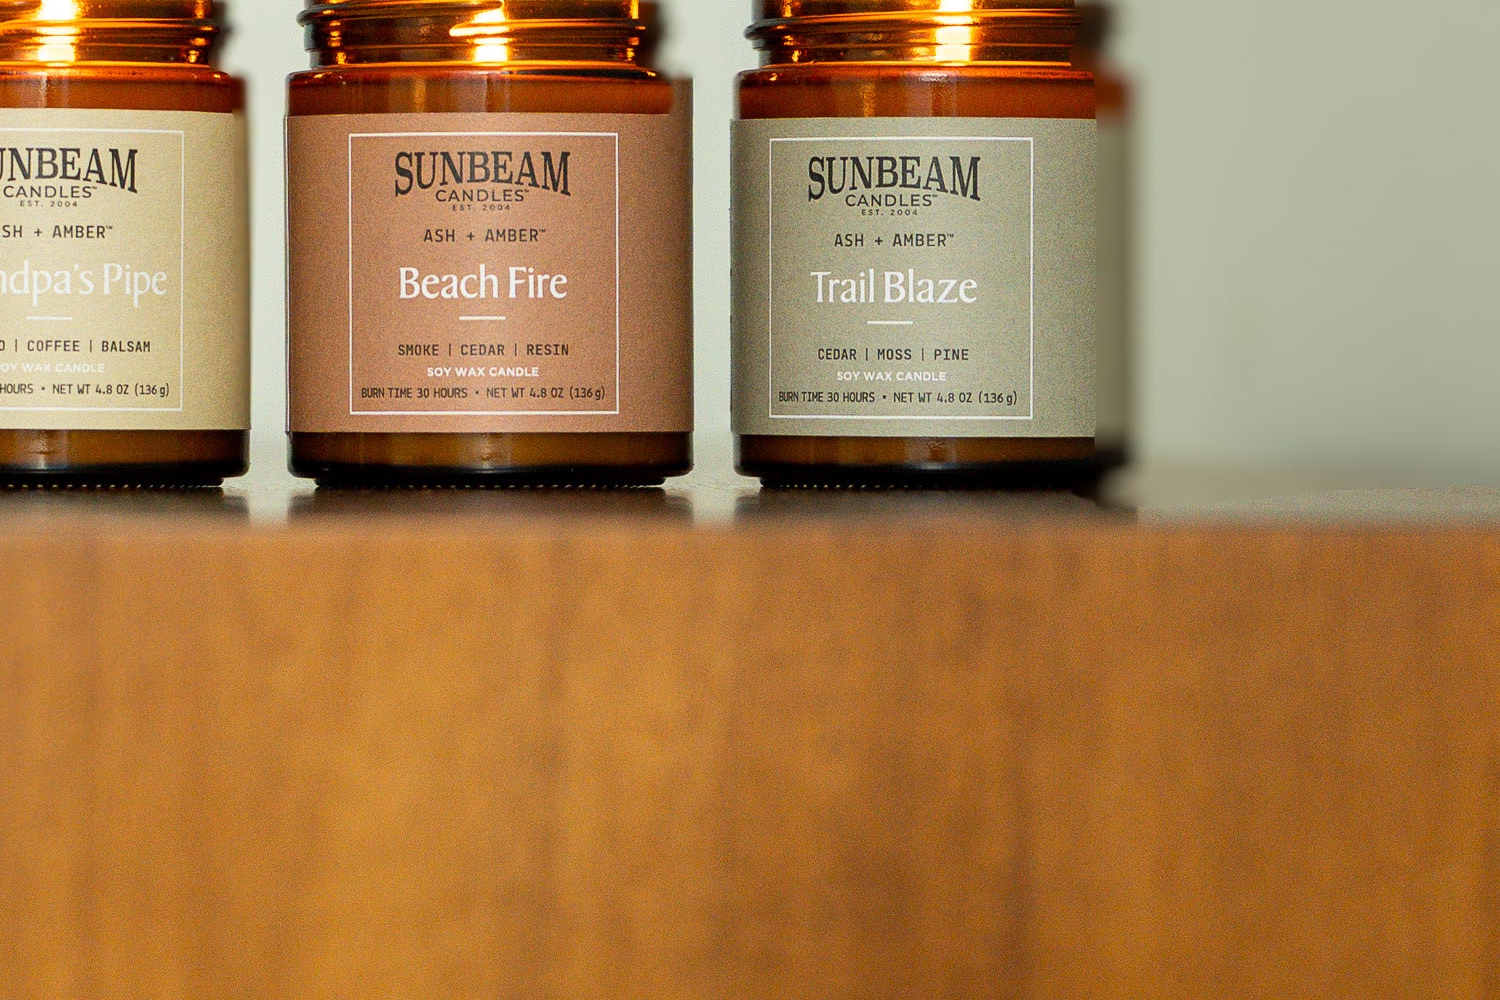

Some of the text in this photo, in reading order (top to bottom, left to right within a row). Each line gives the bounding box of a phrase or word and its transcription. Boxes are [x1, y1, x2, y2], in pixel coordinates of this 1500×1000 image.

[395, 151, 571, 197] SUNBEAM
[808, 156, 981, 202] SUNBEAM
[424, 229, 455, 242] ASH
[834, 234, 864, 246] ASH
[102, 262, 167, 308] Pipe
[400, 264, 568, 299] Beach Fire
[810, 268, 978, 303] Trail Blaze
[27, 340, 80, 352] COFFEE
[101, 341, 151, 352] BALSAM
[398, 344, 569, 356] SMOKE CEDAR RESIN
[818, 348, 969, 361] CEDAR MOSS PINE
[21, 363, 51, 372] WAX
[55, 363, 105, 373] CANDLE
[427, 367, 539, 377] SOY WAX CANDLE
[836, 372, 946, 381] SOY WAX CANDLE
[0, 384, 33, 394] HOURS
[52, 384, 73, 394] NET
[77, 384, 91, 394] WT
[95, 384, 112, 395] 4.8
[116, 384, 129, 395] OZ
[361, 388, 384, 398] BURN
[388, 388, 412, 398] TIME
[417, 388, 430, 398] 30
[434, 388, 468, 398] HOURS
[486, 388, 507, 398] NET
[511, 388, 525, 398] WT
[529, 388, 547, 398] 4.8
[550, 388, 564, 398] OZ
[778, 392, 798, 402] BURN
[802, 392, 823, 402] TIME
[827, 392, 839, 402] 30
[843, 392, 875, 403] HOURS
[893, 392, 913, 403] NET
[918, 392, 932, 403] WT
[936, 392, 954, 403] 4.8
[958, 392, 972, 403] OZ
